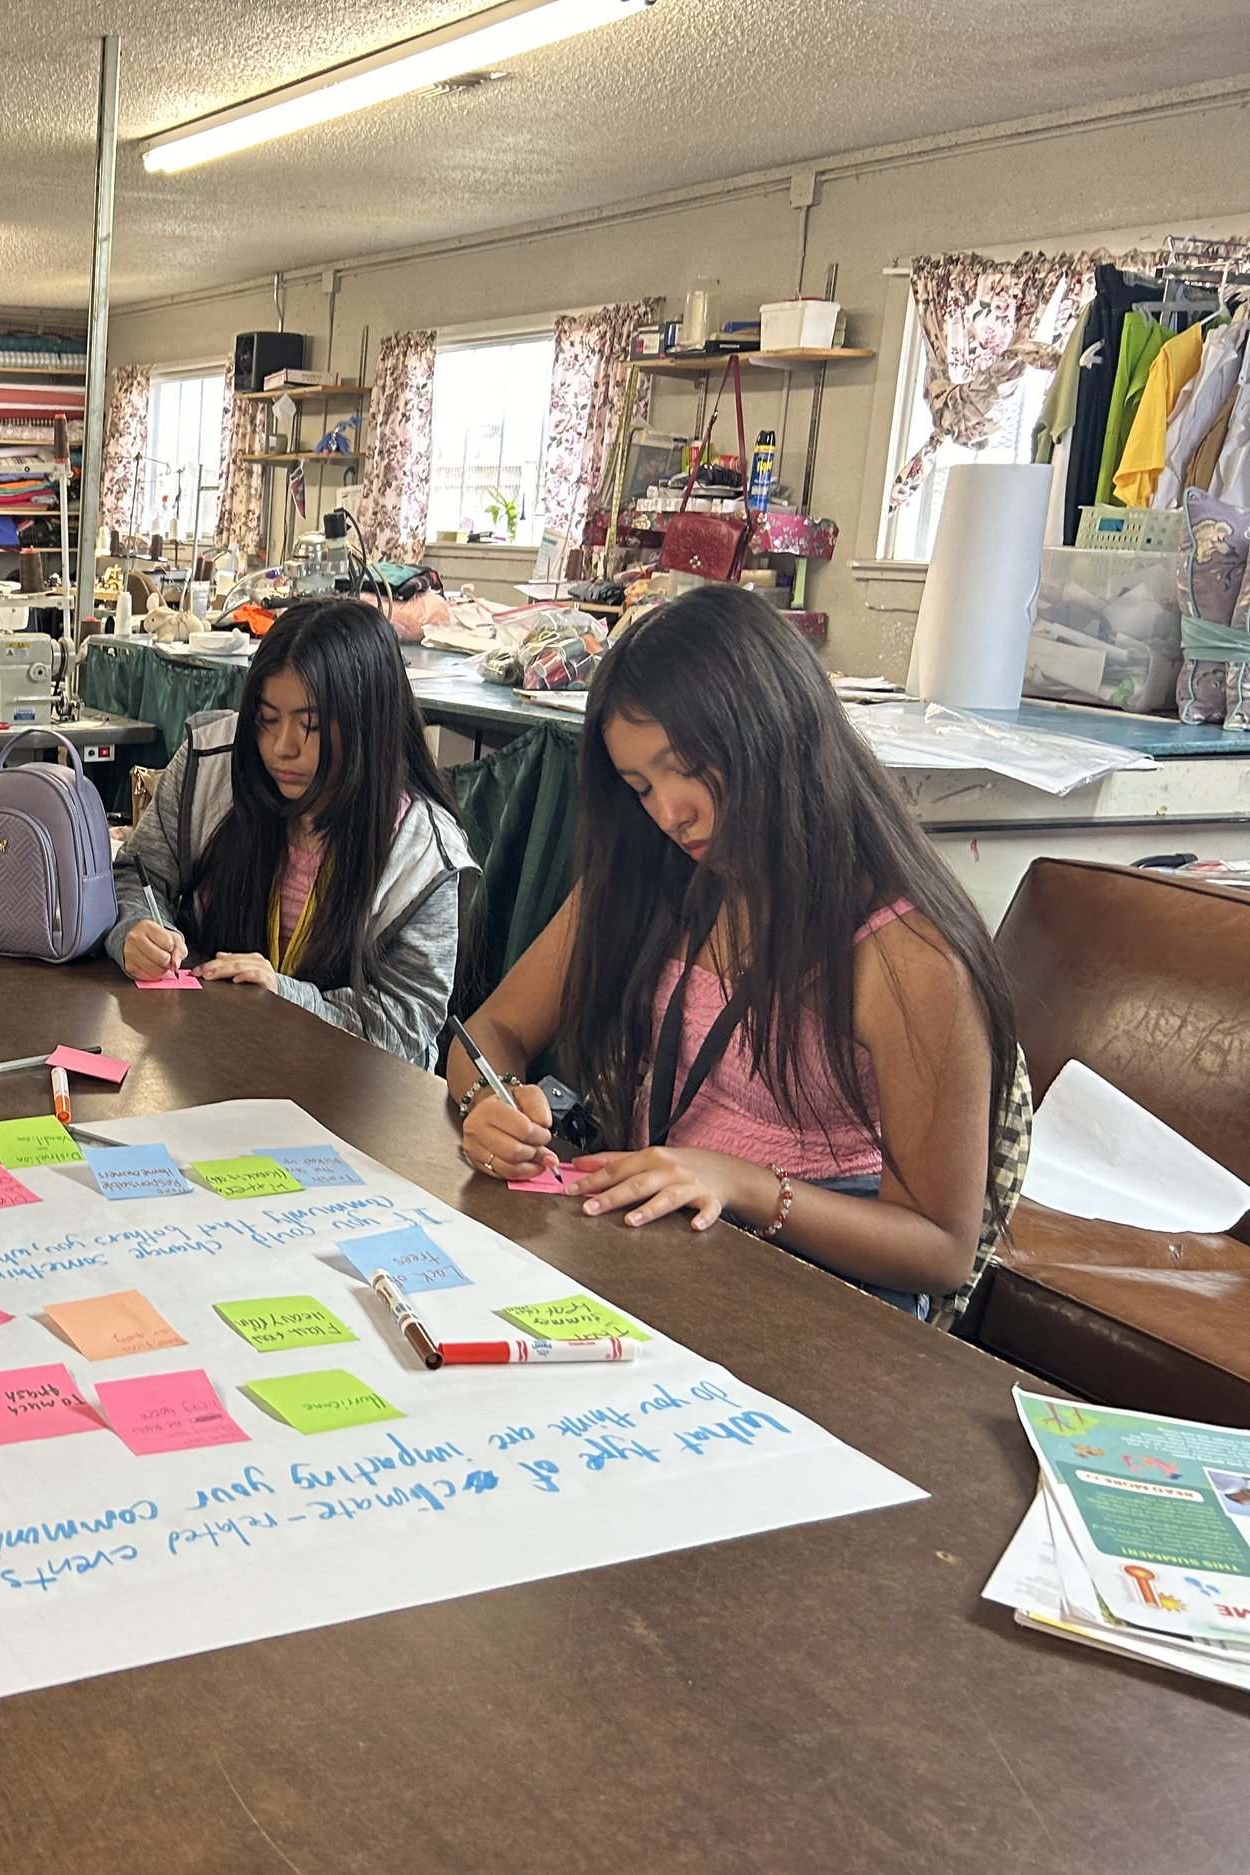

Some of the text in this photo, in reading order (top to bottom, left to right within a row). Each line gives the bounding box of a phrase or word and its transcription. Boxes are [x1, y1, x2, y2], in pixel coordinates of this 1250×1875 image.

[262, 1195, 395, 1225] community
[331, 1210, 381, 1230] you
[393, 1206, 448, 1229] If
[93, 1223, 192, 1246] bothers
[198, 1217, 257, 1239] that
[250, 1223, 317, 1249] could
[128, 1239, 223, 1260] change
[392, 1250, 443, 1266] trees
[532, 1312, 601, 1326] summer
[301, 1392, 388, 1411] Hurricane
[639, 1383, 692, 1415] you
[690, 1380, 743, 1409] do
[547, 1406, 637, 1438] think
[673, 1409, 793, 1456] What
[487, 1425, 536, 1451] are
[579, 1434, 661, 1471] type
[186, 1465, 276, 1511] your
[518, 1458, 561, 1493] of
[0, 1543, 138, 1591] events
[1202, 1559, 1241, 1573] THIS
